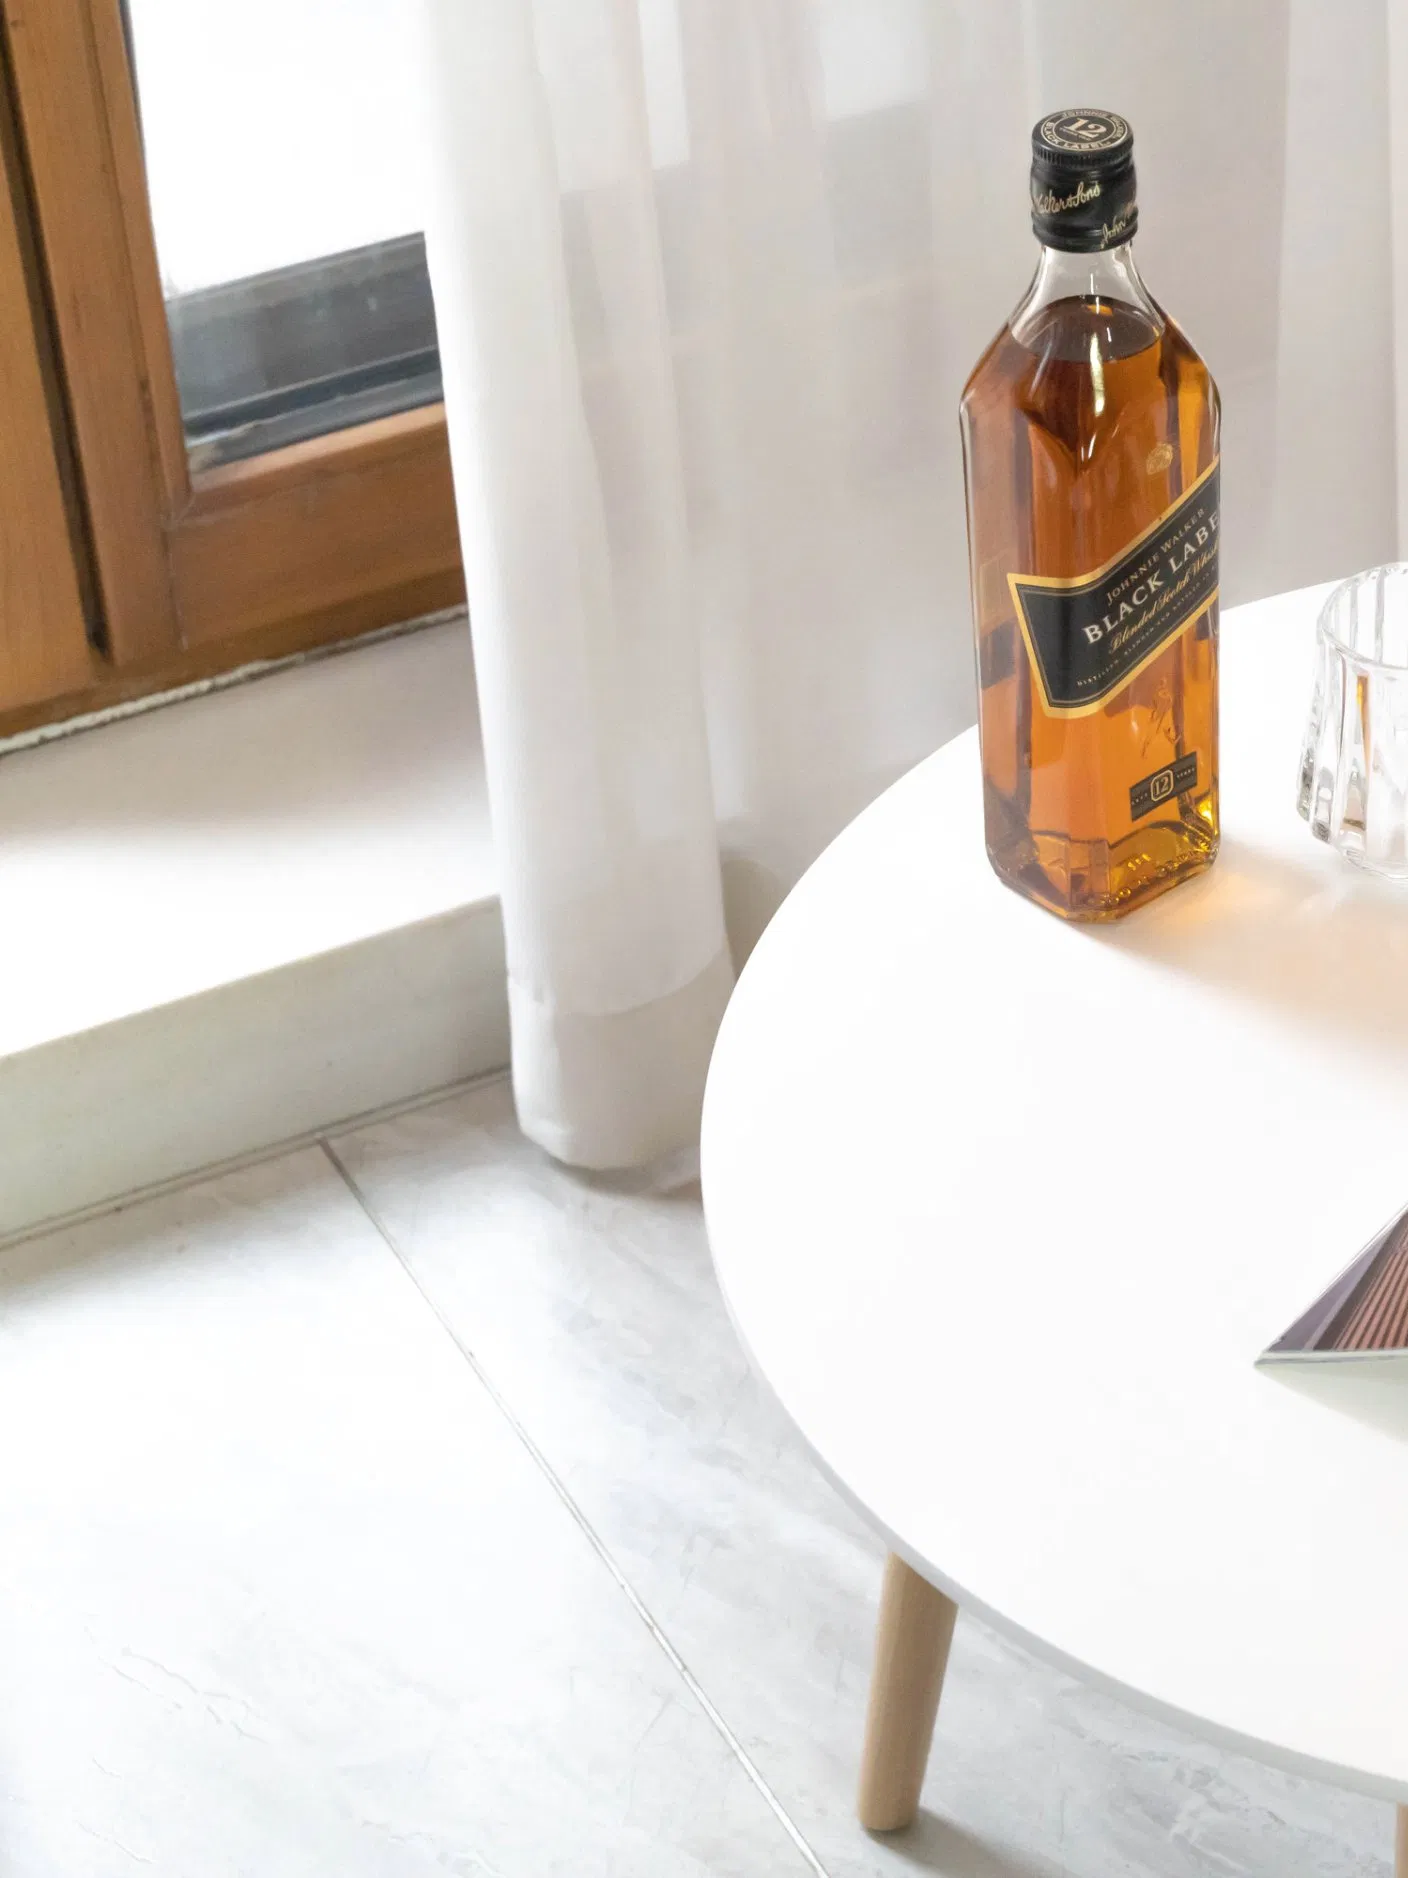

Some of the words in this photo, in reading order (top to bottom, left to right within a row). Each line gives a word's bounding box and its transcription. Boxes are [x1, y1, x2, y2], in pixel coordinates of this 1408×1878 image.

[1063, 118, 1107, 139] 12
[1082, 569, 1164, 644] BLACK
[1168, 512, 1218, 574] LABE
[1107, 553, 1160, 606] JOHNNIE
[1160, 508, 1205, 553] WALKER
[1108, 600, 1159, 655] Blended
[1155, 776, 1169, 797] 12
